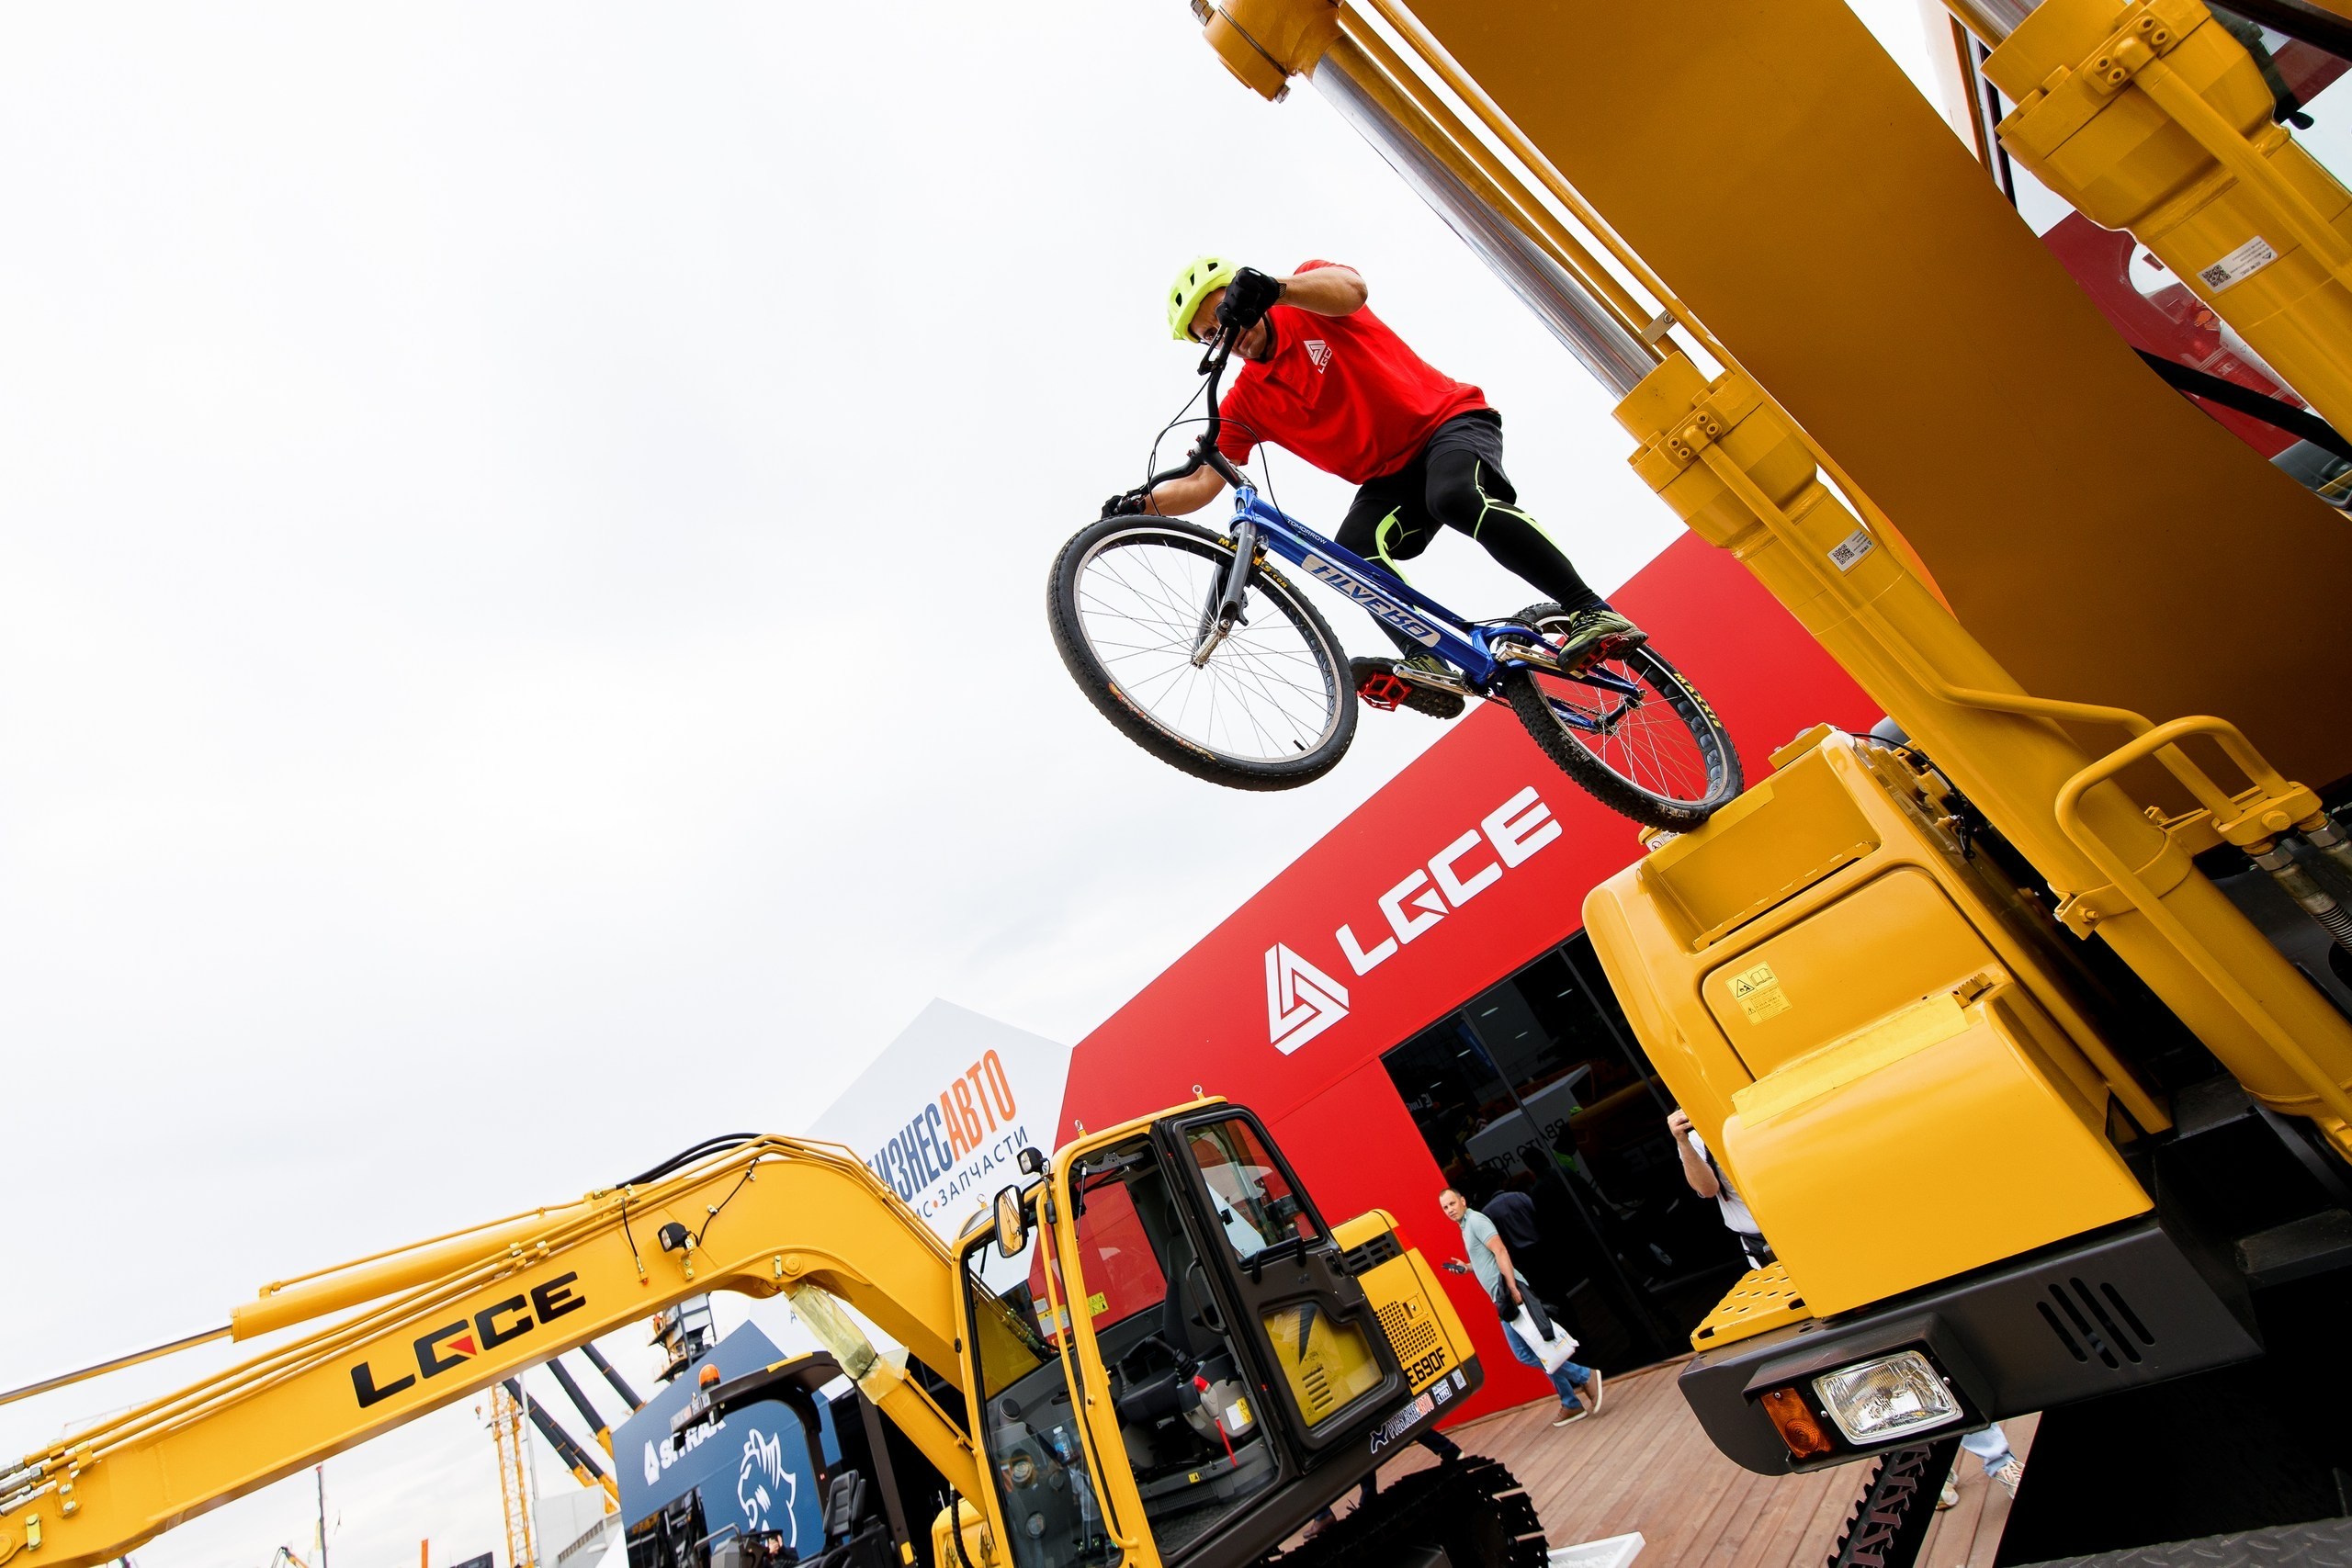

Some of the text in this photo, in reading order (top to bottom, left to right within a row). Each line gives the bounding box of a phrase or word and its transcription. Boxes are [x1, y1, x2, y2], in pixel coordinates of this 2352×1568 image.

[1286, 518, 1328, 545] TOMORROW
[1673, 671, 1722, 728] MAXXIS
[1334, 785, 1563, 977] LGCE
[866, 1048, 1017, 1203] ИЗНЕСАВТО
[938, 1125, 1029, 1207] ЗАПЧАСТИ
[350, 1270, 587, 1409] LGCE
